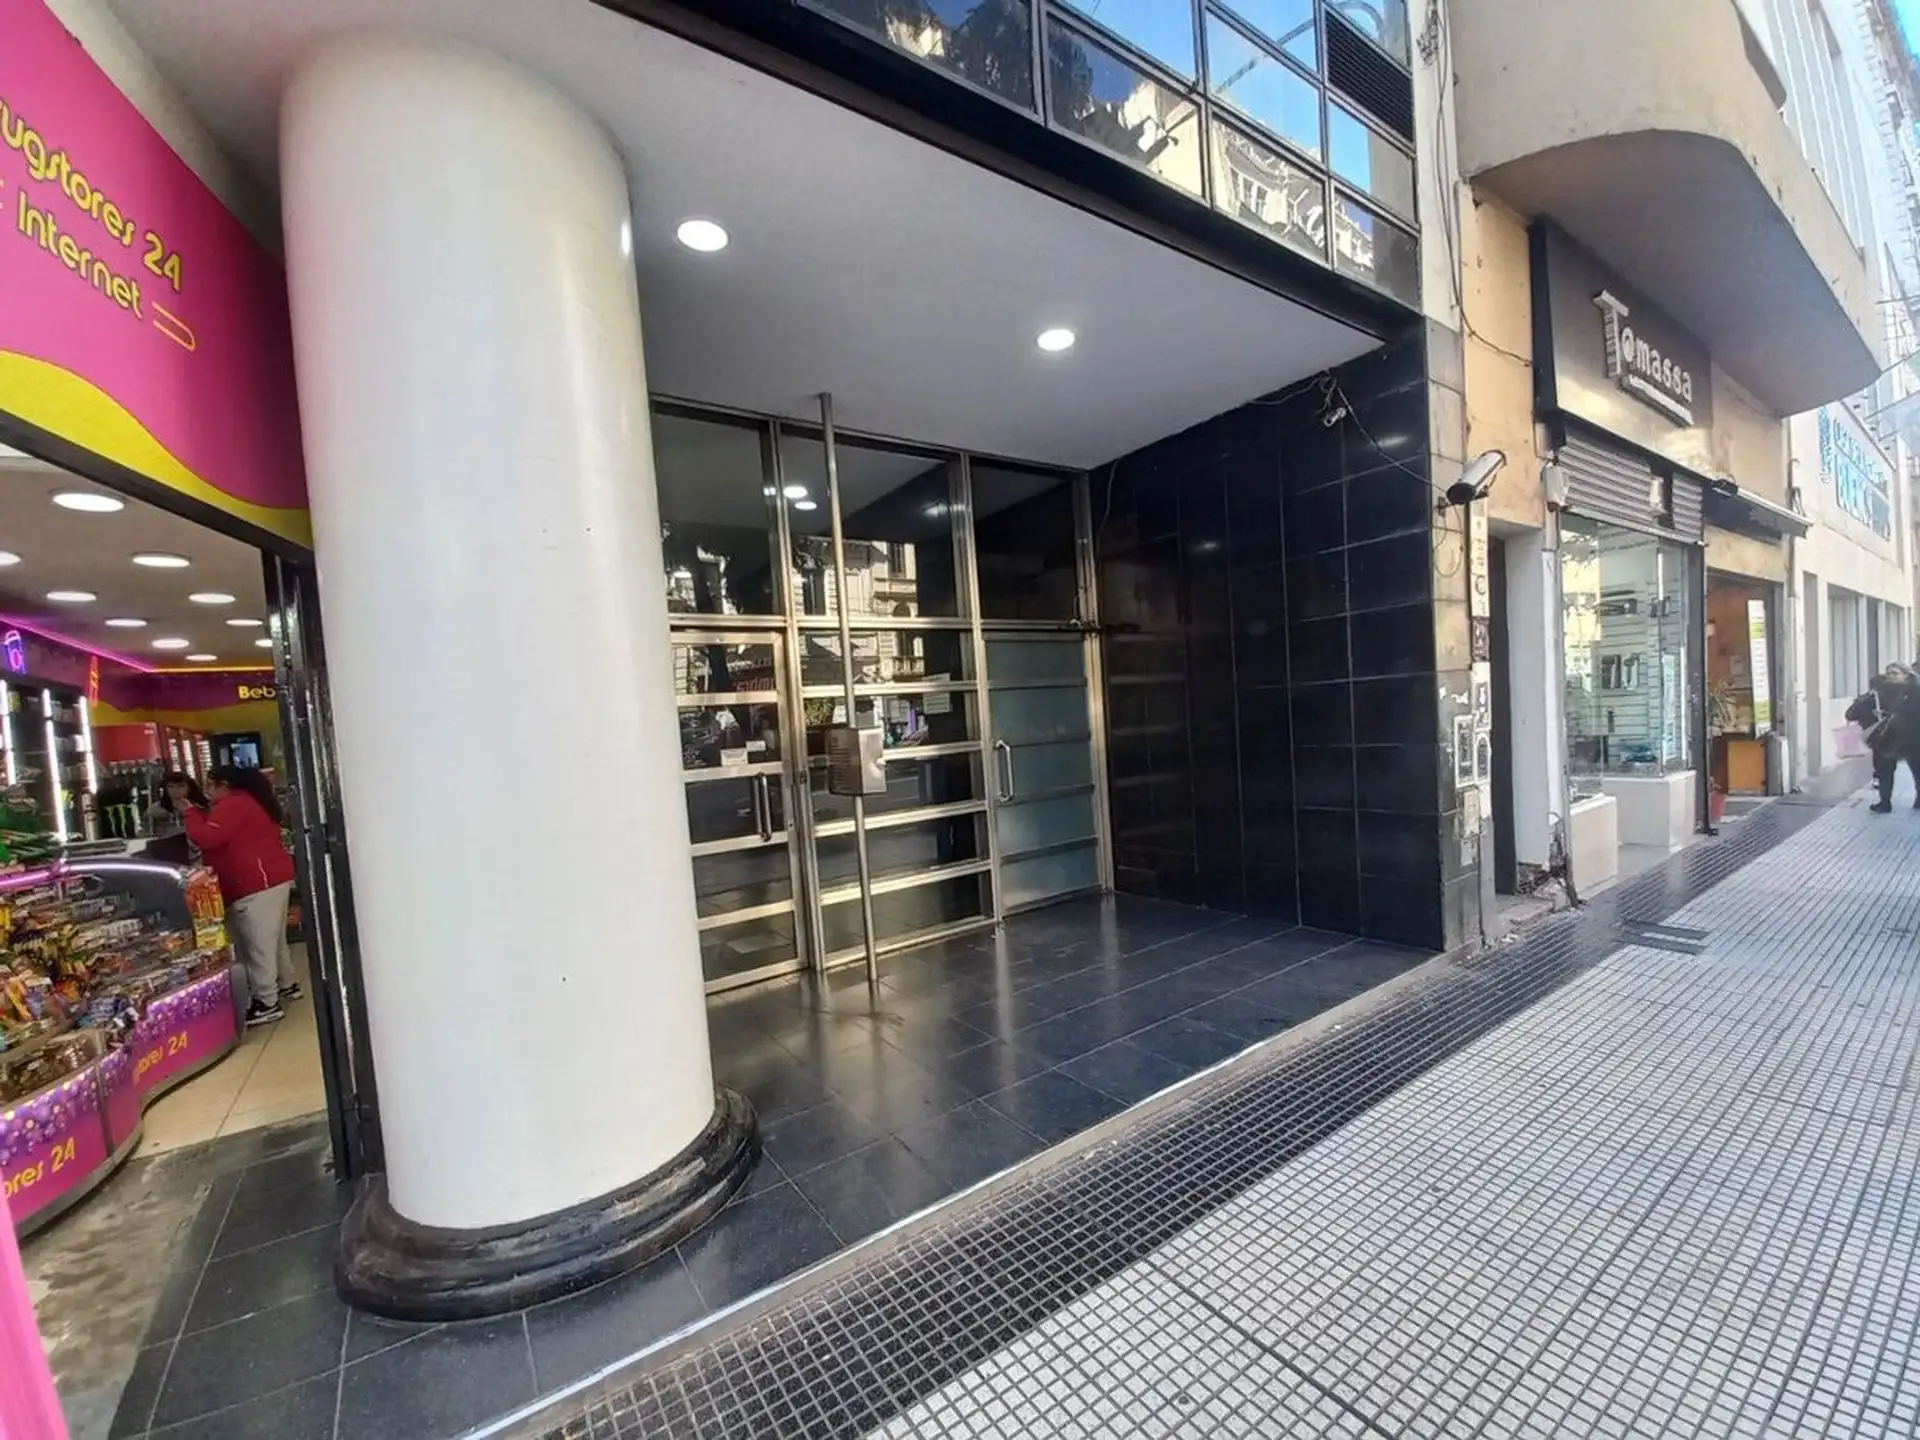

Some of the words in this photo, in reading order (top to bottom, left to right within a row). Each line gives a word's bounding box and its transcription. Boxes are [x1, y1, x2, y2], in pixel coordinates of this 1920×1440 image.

[17, 189, 144, 321] Internet
[142, 231, 182, 292] 24
[1593, 289, 1693, 403] Tomassa
[168, 1030, 189, 1057] 24
[51, 1136, 77, 1175] 24
